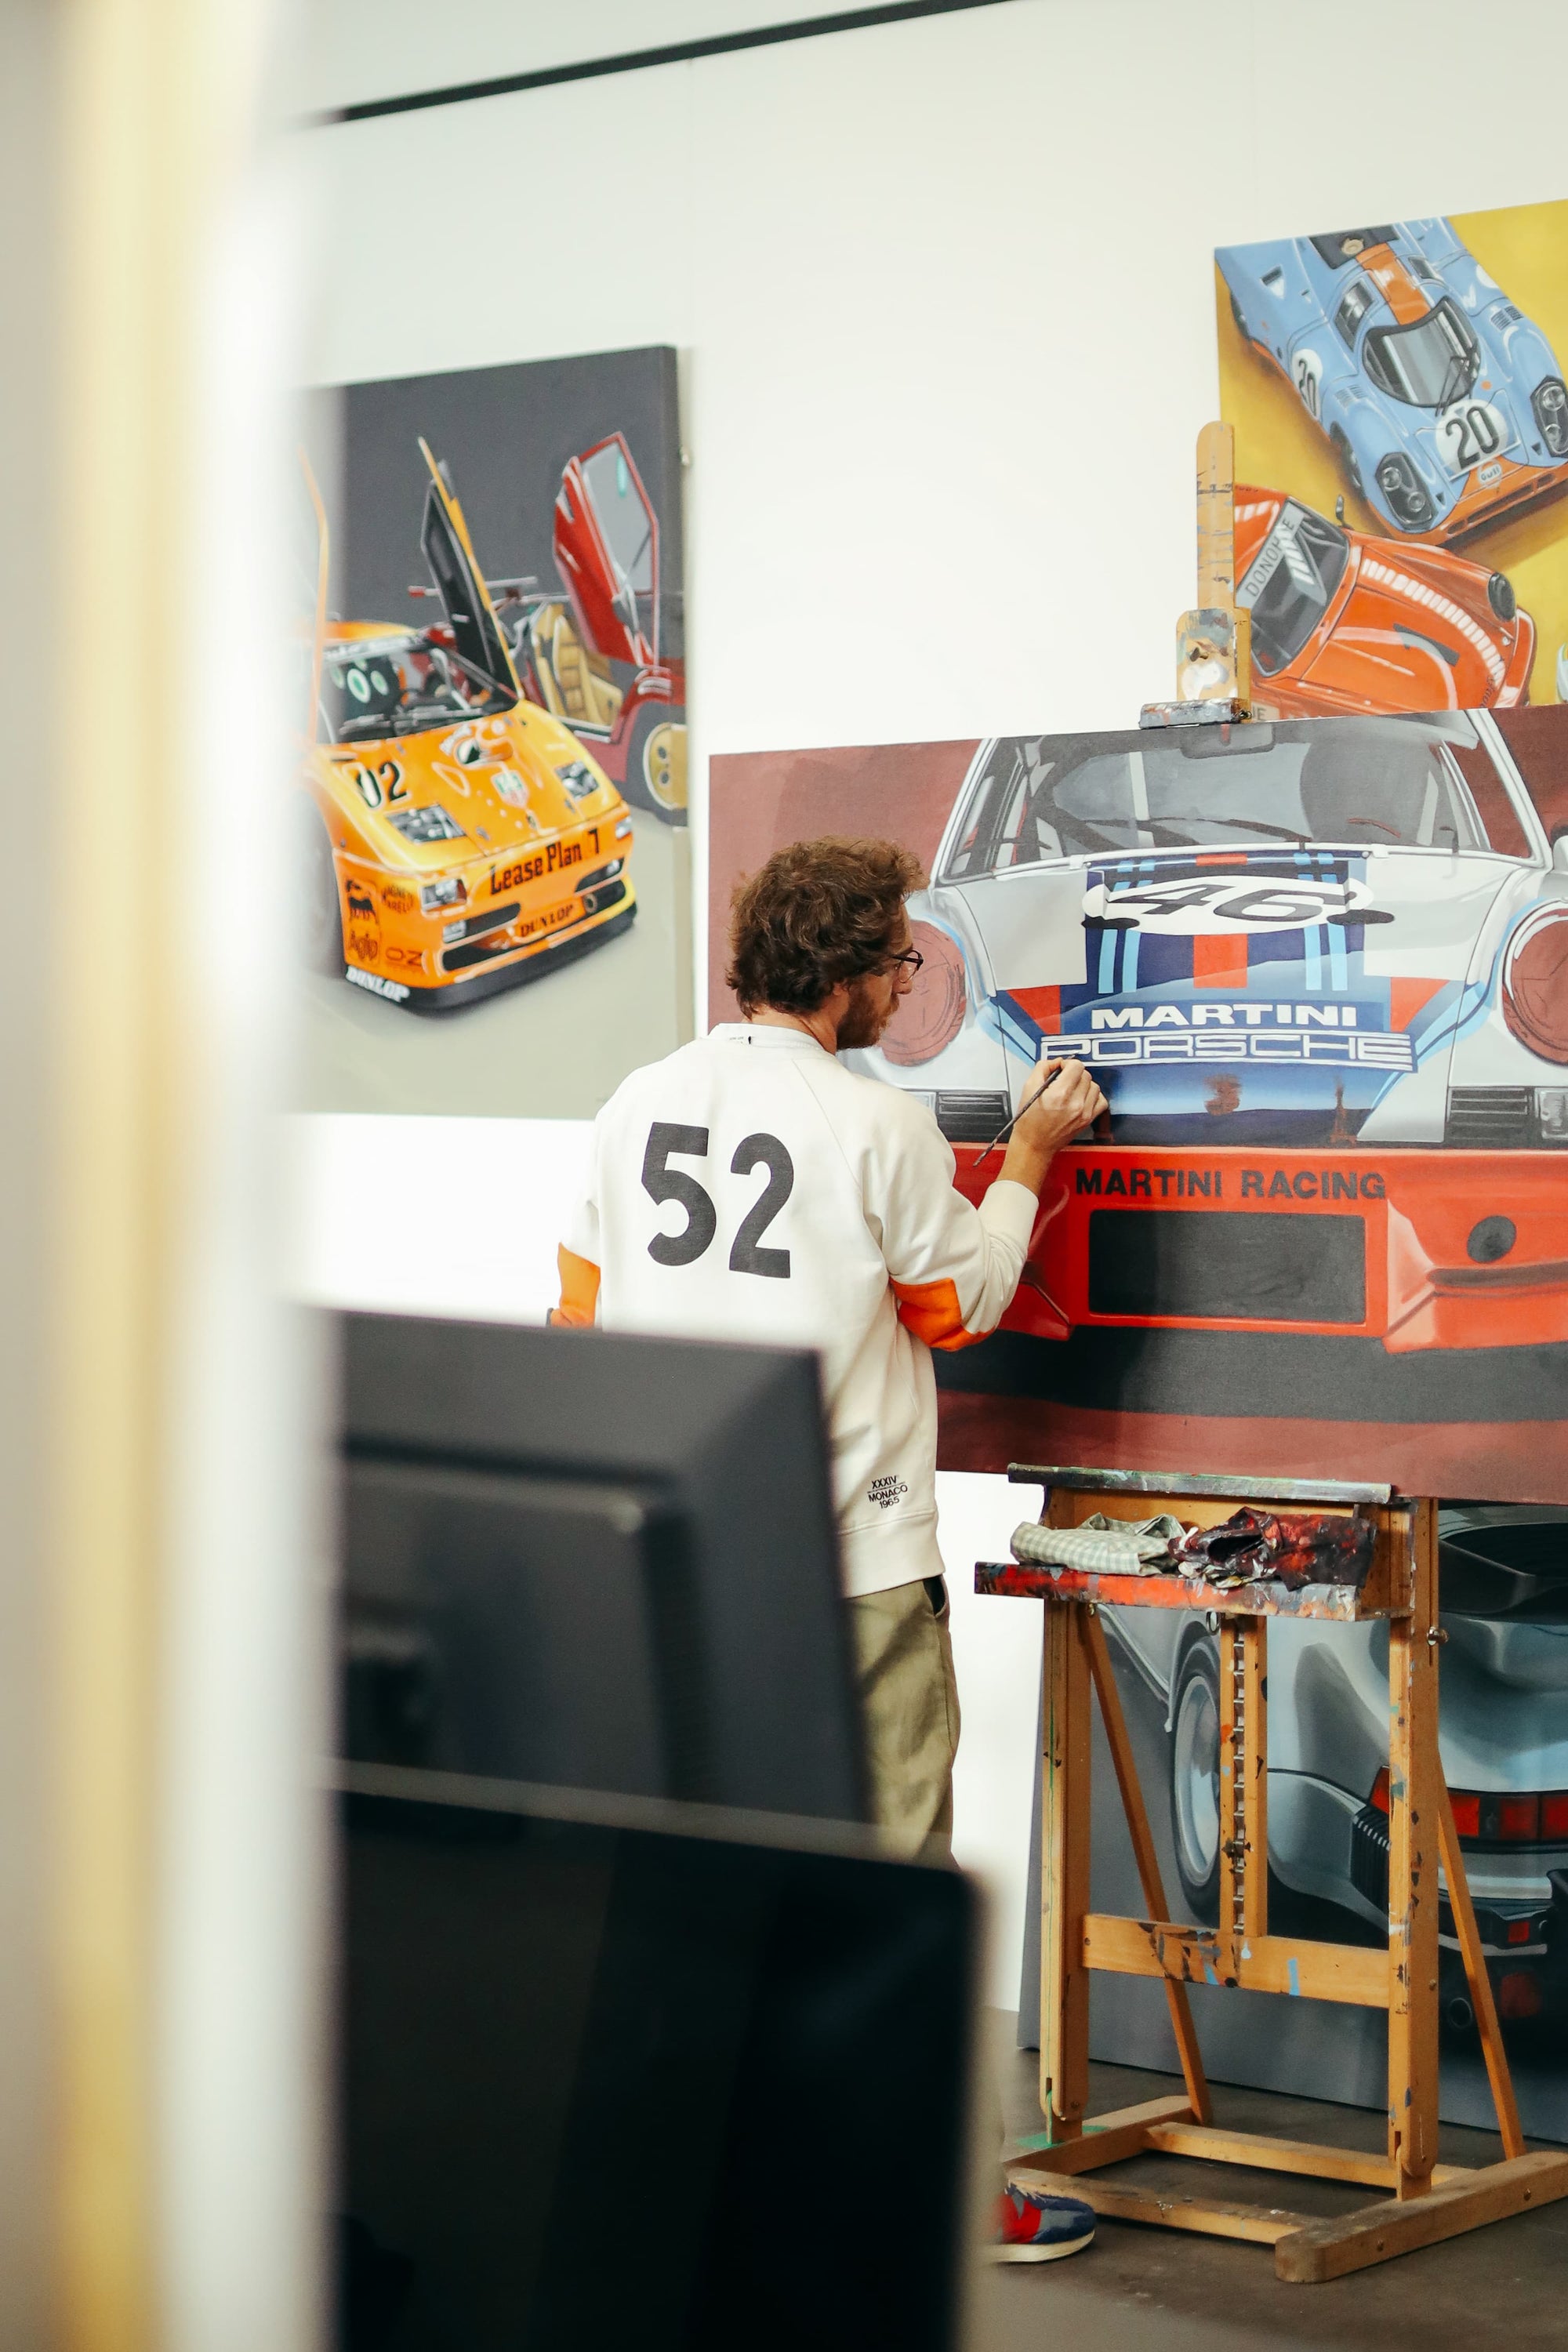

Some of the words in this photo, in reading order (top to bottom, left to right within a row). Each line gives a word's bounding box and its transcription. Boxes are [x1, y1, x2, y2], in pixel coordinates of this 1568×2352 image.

[1445, 405, 1500, 470] 20
[1245, 517, 1294, 597] DONOHE
[356, 760, 408, 808] 02
[490, 857, 543, 895] Lease
[546, 840, 583, 873] Plan
[521, 904, 574, 937] DUNLOP
[1105, 884, 1356, 922] 46
[346, 965, 410, 1003] DUNLOP
[1091, 1004, 1357, 1029] MARTINI
[1041, 1034, 1412, 1063] PORSCHE
[641, 1122, 794, 1279] 52
[1076, 1169, 1221, 1198] MARTINI
[1242, 1171, 1386, 1200] RACING
[868, 1484, 908, 1502] MONACO
[872, 1475, 897, 1489] XXXIV
[880, 1496, 899, 1508] 1965
